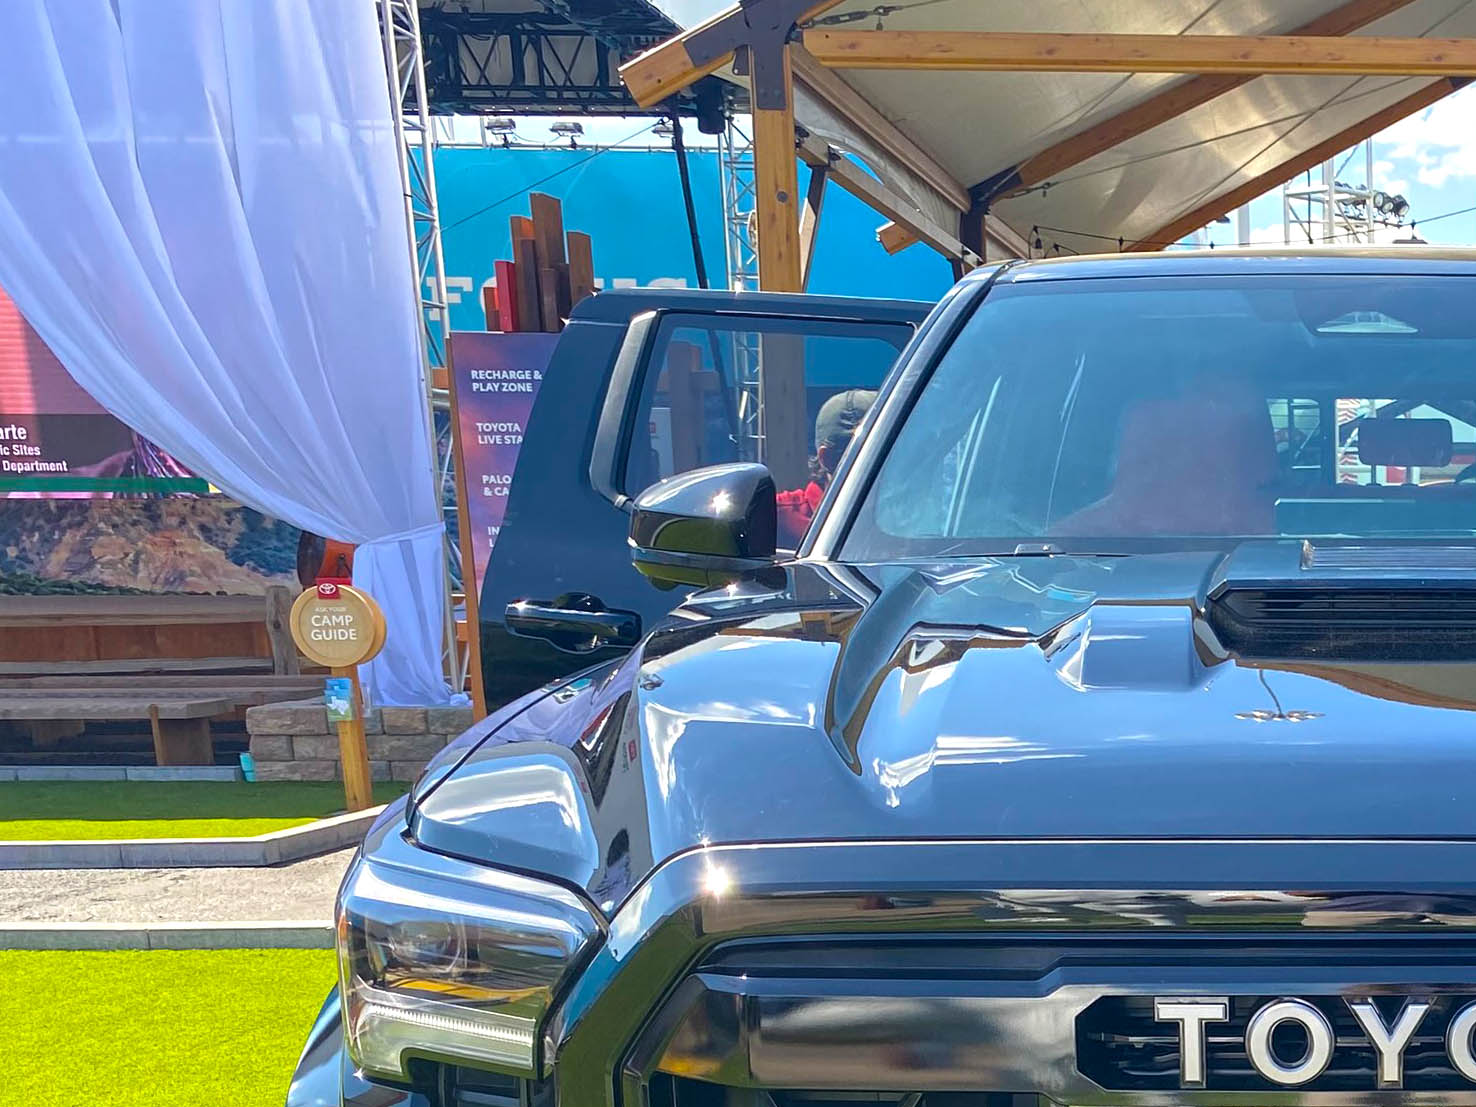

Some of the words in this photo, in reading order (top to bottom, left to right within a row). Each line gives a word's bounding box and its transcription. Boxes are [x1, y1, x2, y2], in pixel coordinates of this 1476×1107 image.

[471, 370, 532, 380] RECHARGE
[533, 370, 543, 379] &
[472, 383, 500, 392] PLAY
[501, 383, 533, 392] ZONE
[476, 423, 521, 432] TOYOTA
[478, 435, 502, 445] LIVE
[12, 444, 41, 456] Sites
[3, 460, 68, 473] Department
[484, 487, 492, 496] &
[311, 615, 353, 627] CAMP
[311, 629, 357, 641] GUIDE
